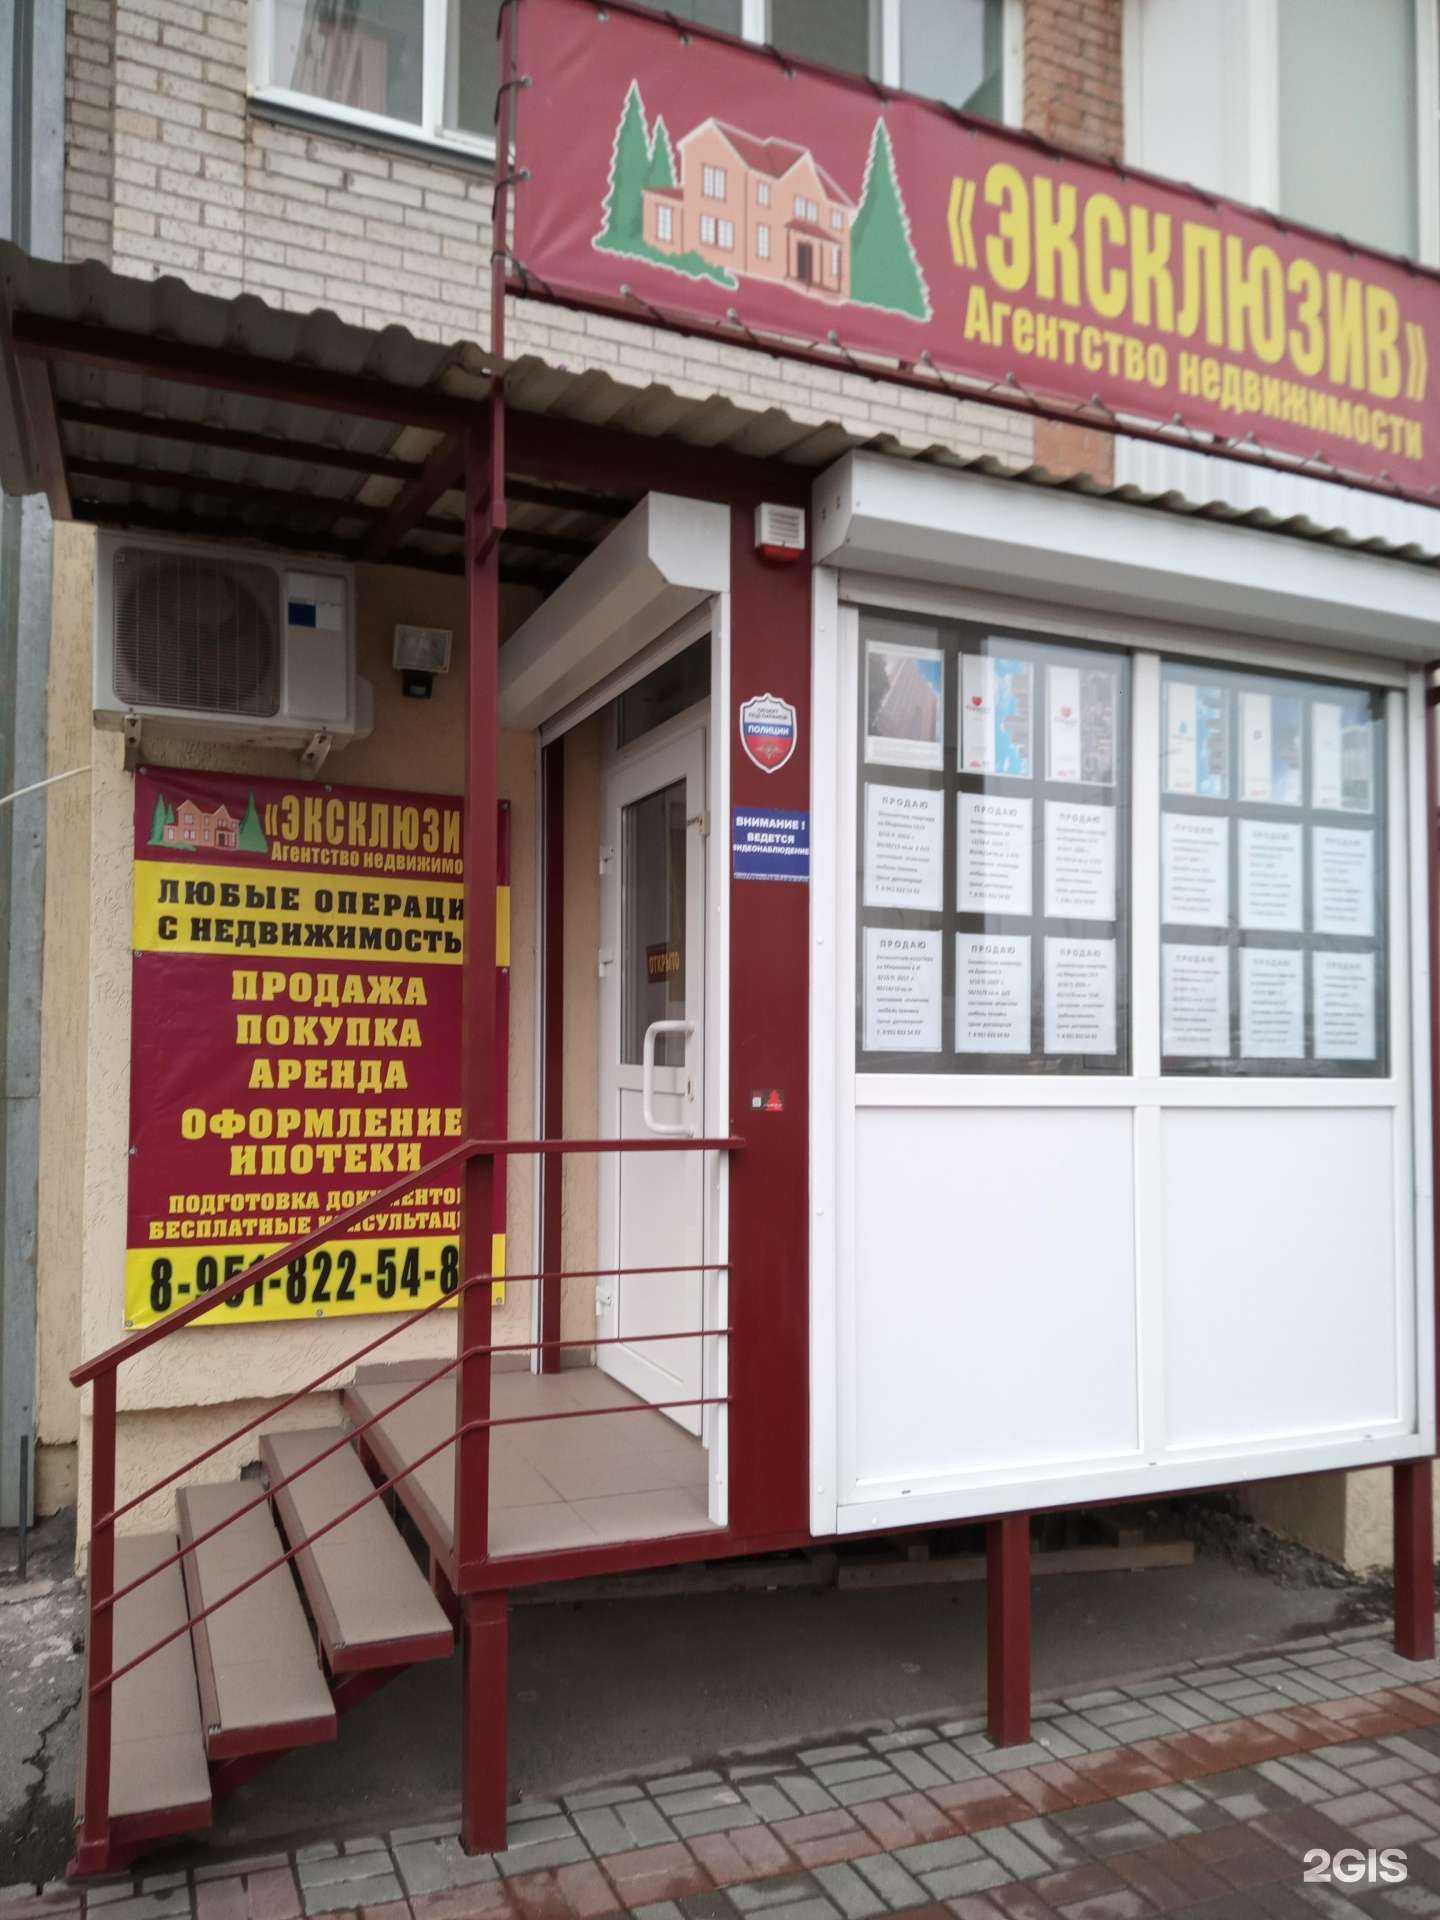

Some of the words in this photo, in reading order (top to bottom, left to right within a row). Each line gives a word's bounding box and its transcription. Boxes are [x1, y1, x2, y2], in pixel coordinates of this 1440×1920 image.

[947, 162, 1428, 402] «ЭКСКЛЮЗИВ»
[963, 285, 1168, 388] Агентство
[1179, 351, 1424, 460] недвижимости
[747, 724, 790, 736] ПОЛИЦИИ
[882, 796, 929, 809] ПРОДАЮ
[974, 804, 1018, 817] ПРОДАЮ
[265, 794, 461, 854] «ЭКСКЛЮЗИ
[736, 816, 799, 830] ВНИМАНИЕ
[747, 832, 796, 844] ВЕДЕТСЯ
[271, 841, 360, 868] Агентство
[363, 851, 464, 875] недвижимо
[158, 879, 300, 911] ЛЮБЫЕ
[314, 889, 464, 923] ОПЕРАЦИ
[158, 915, 178, 940] С
[190, 917, 462, 955] НЕДВИЖИМОСТЬ
[880, 939, 927, 949] ПРОДАЮ
[970, 944, 1016, 954] ПРОДАЮ
[231, 970, 427, 1008] ПРОДАЖА
[236, 1014, 422, 1047] ПОКУПКА
[248, 1058, 408, 1094] АРЕНДА
[181, 1107, 463, 1140] ОФОРМЛЕНИЕ
[229, 1142, 422, 1176] ИПОТЕКИ
[169, 1192, 320, 1215] ПОДГОТОВКА
[325, 1187, 460, 1212] ДОКЕНТО
[148, 1215, 311, 1241] БЕСПЛАТНЫЕ
[150, 1245, 460, 1312] 8-951-822-54-8
